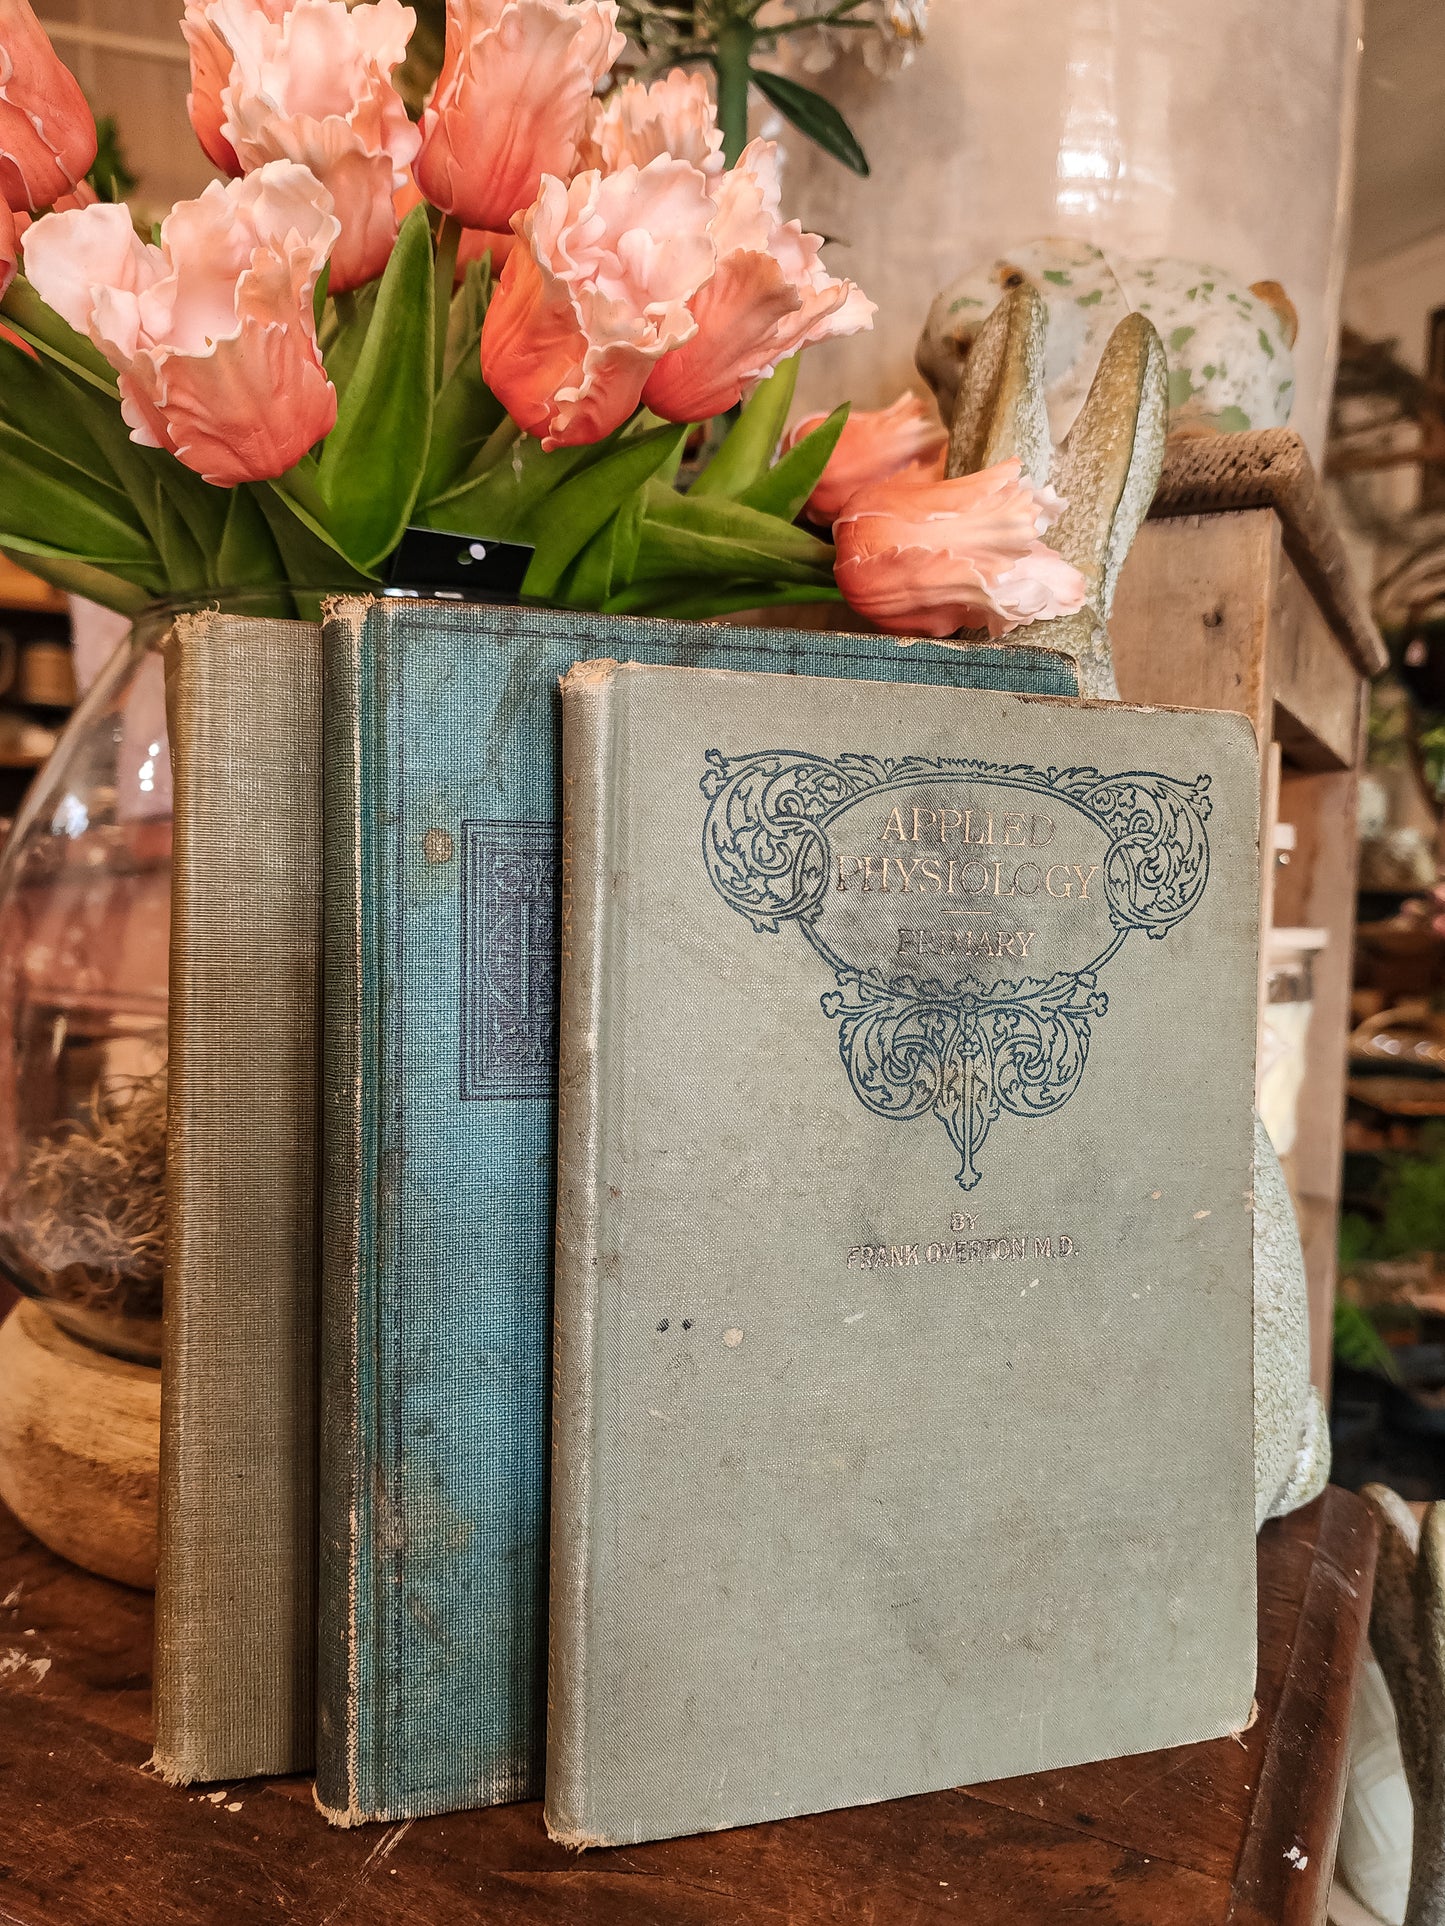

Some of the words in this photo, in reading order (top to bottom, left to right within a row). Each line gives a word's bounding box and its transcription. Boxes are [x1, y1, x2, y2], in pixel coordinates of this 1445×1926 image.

[880, 807, 1056, 848] APPLIED
[836, 855, 1099, 899] PHYSIOLOGY
[951, 1212, 979, 1231] BY
[847, 1244, 919, 1270] FRANK
[925, 1238, 1025, 1264] OVERTON
[1034, 1235, 1079, 1258] M.D.
